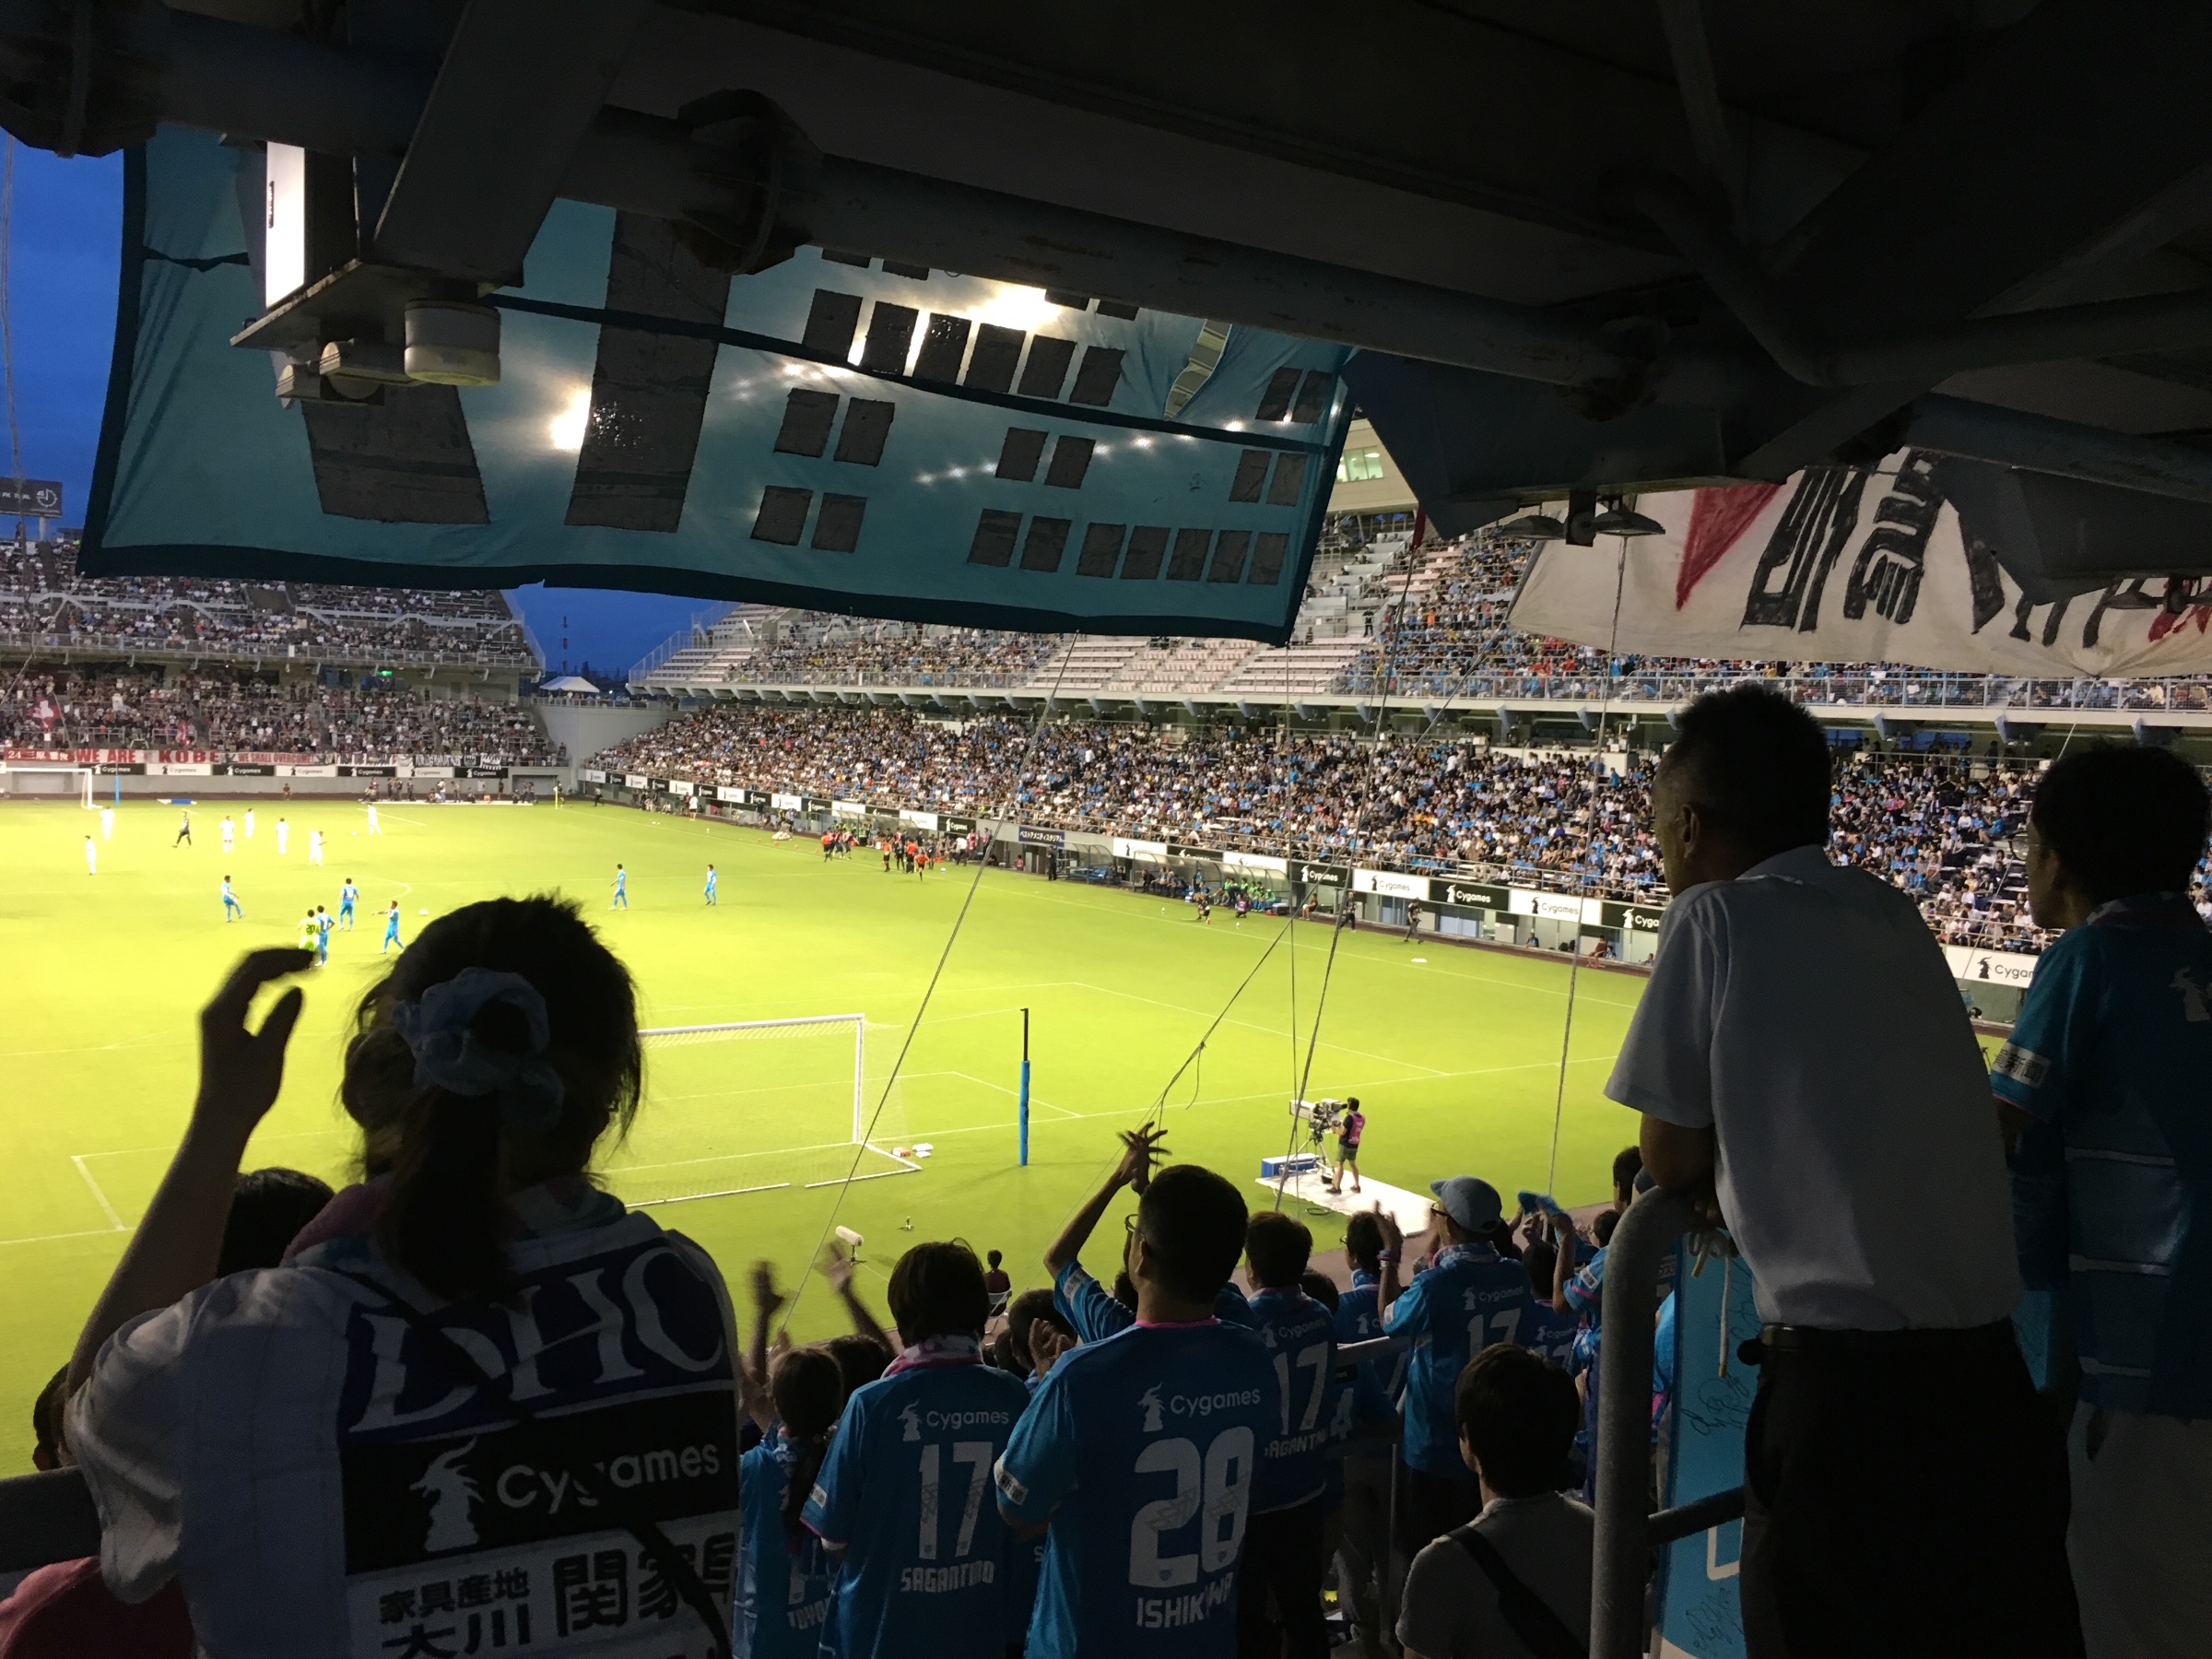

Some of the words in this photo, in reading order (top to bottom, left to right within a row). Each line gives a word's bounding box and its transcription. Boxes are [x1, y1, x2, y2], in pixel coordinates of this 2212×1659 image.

[8, 750, 22, 759] 24
[76, 748, 100, 762] WE
[107, 748, 135, 763] ARE
[159, 749, 219, 763] KOBE
[237, 753, 250, 762] WE
[251, 753, 272, 763] SHALL
[1379, 880, 1410, 891] Cygames
[1455, 889, 1491, 903] Cygames
[1541, 901, 1579, 915] Cygames
[1635, 914, 1660, 928] Cyga
[306, 924, 315, 935] 20
[1994, 964, 2034, 980] Cyga
[348, 1246, 724, 1434] DHC
[1273, 1341, 1328, 1436] 17
[1170, 1388, 1261, 1418] Cygames
[926, 1410, 1009, 1430] Cygames
[919, 1441, 993, 1559] 17
[1128, 1426, 1254, 1589] 28
[379, 1567, 529, 1624] 家具産地
[382, 1602, 531, 1659] 大川
